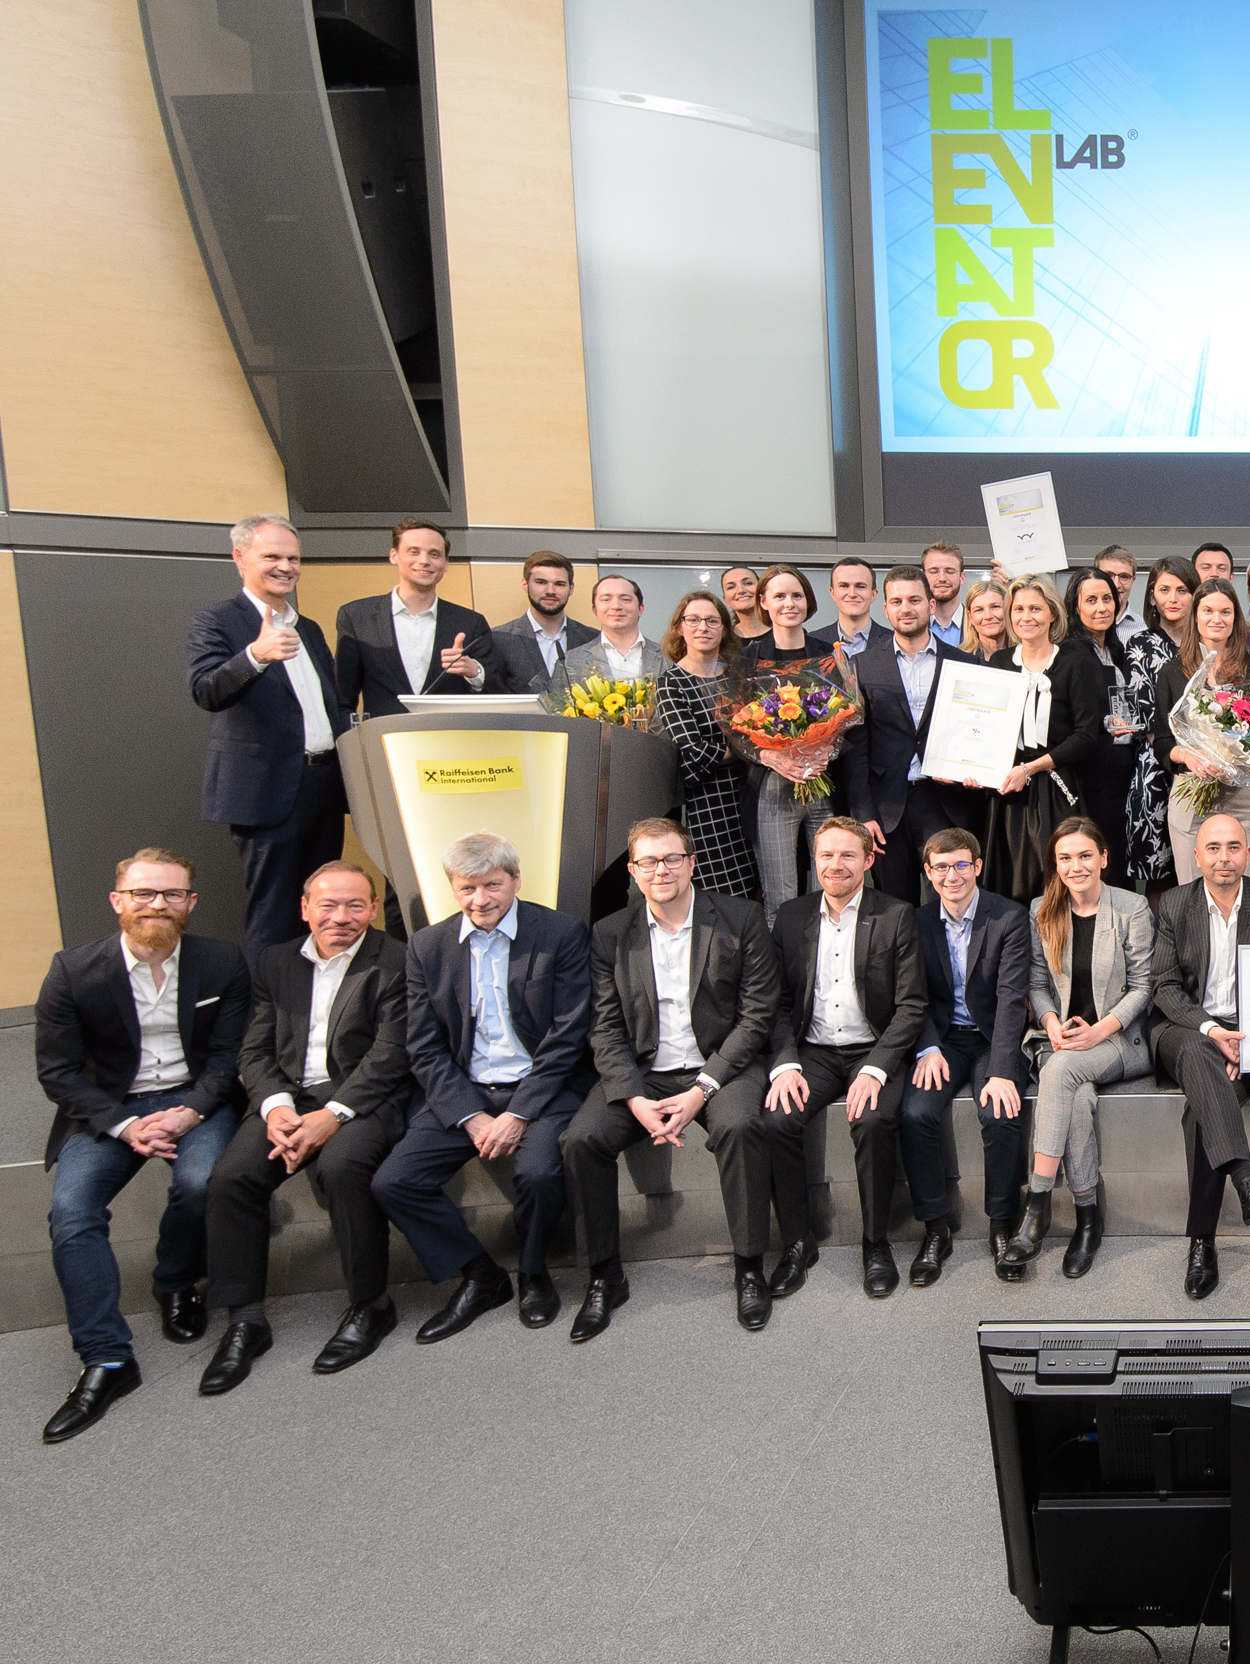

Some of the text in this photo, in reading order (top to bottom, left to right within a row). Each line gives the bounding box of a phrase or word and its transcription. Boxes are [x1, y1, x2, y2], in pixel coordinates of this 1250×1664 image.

[439, 765, 514, 777] Raiffeisen Bank
[440, 775, 497, 784] International
